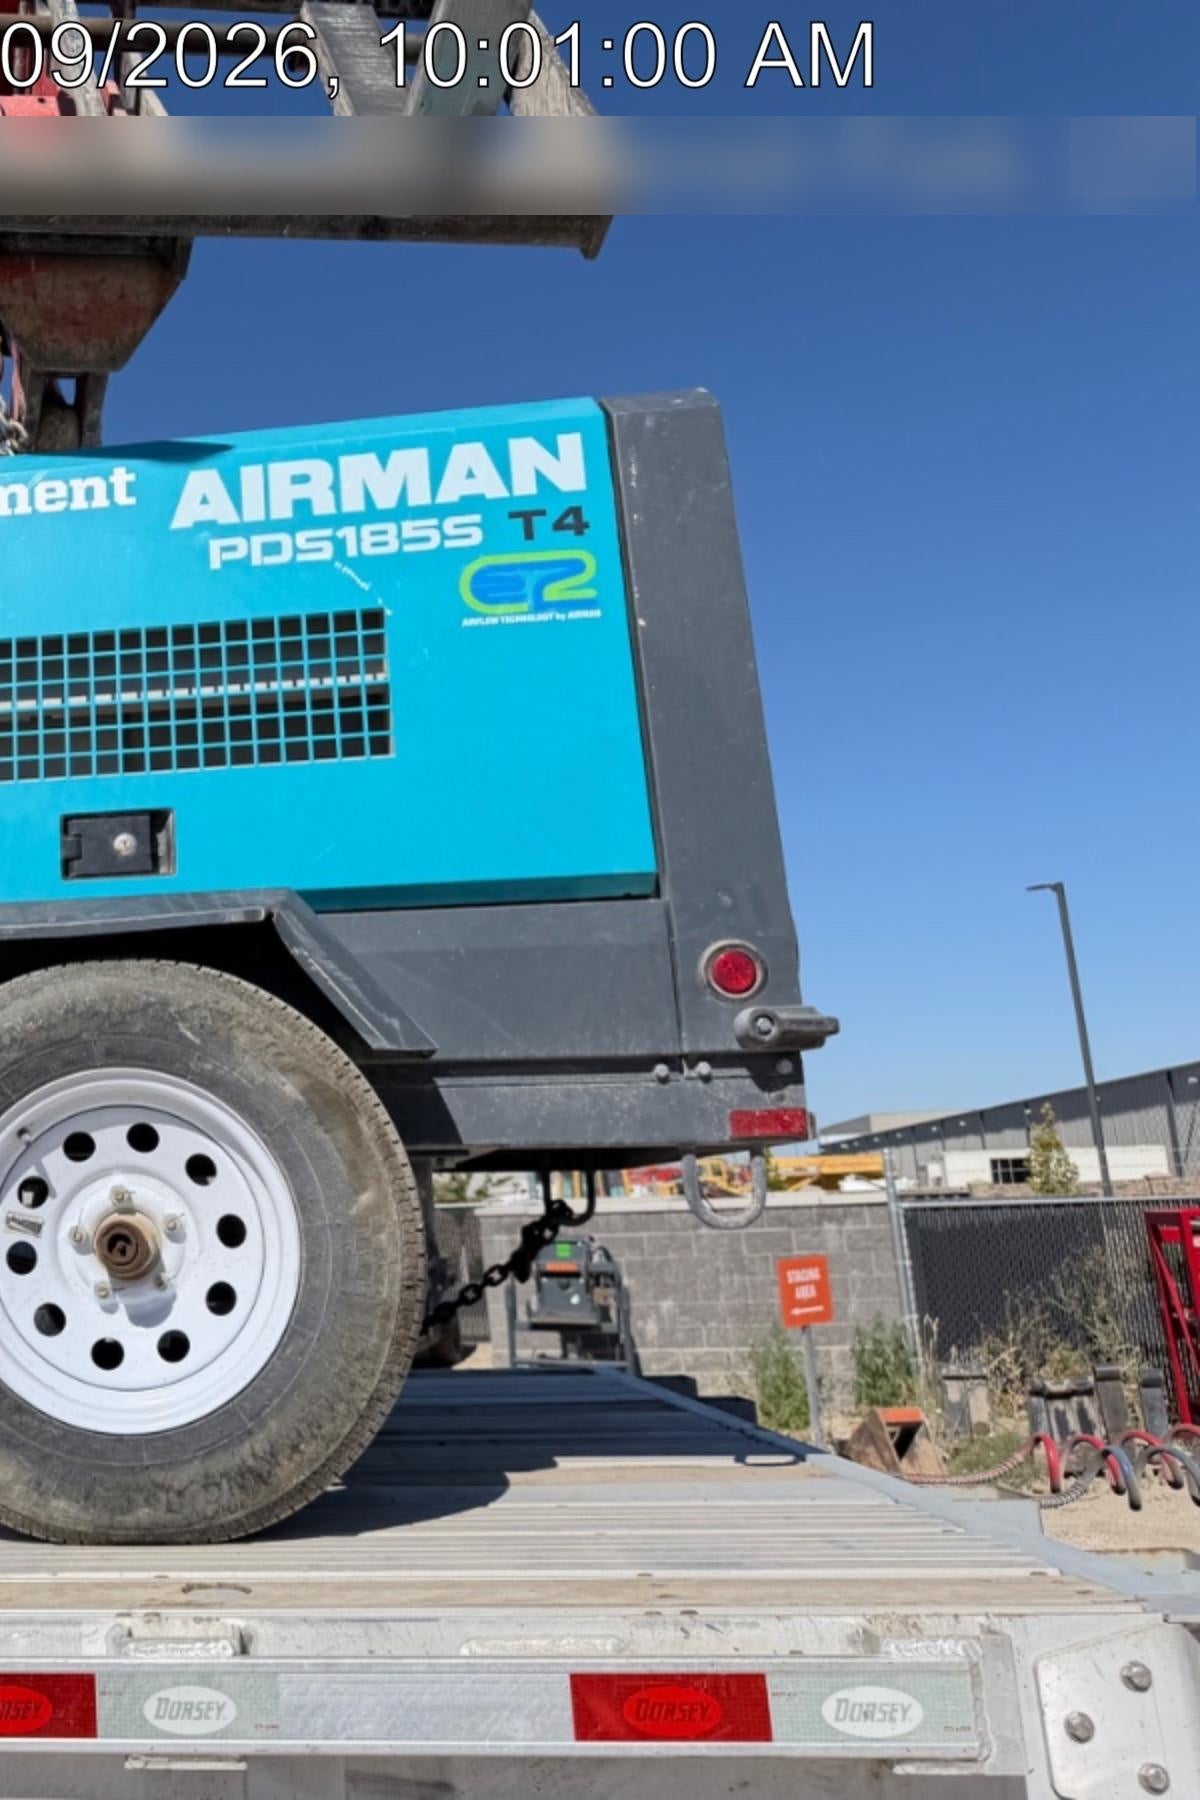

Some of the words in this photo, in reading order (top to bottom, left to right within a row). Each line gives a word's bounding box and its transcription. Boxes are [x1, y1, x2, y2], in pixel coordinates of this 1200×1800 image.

[170, 432, 587, 529] AIRMAN
[209, 513, 483, 570] PDS185S
[153, 1697, 227, 1721] DORSEY
[634, 1698, 714, 1724] DORSEY
[834, 1698, 912, 1724] DORSEY
